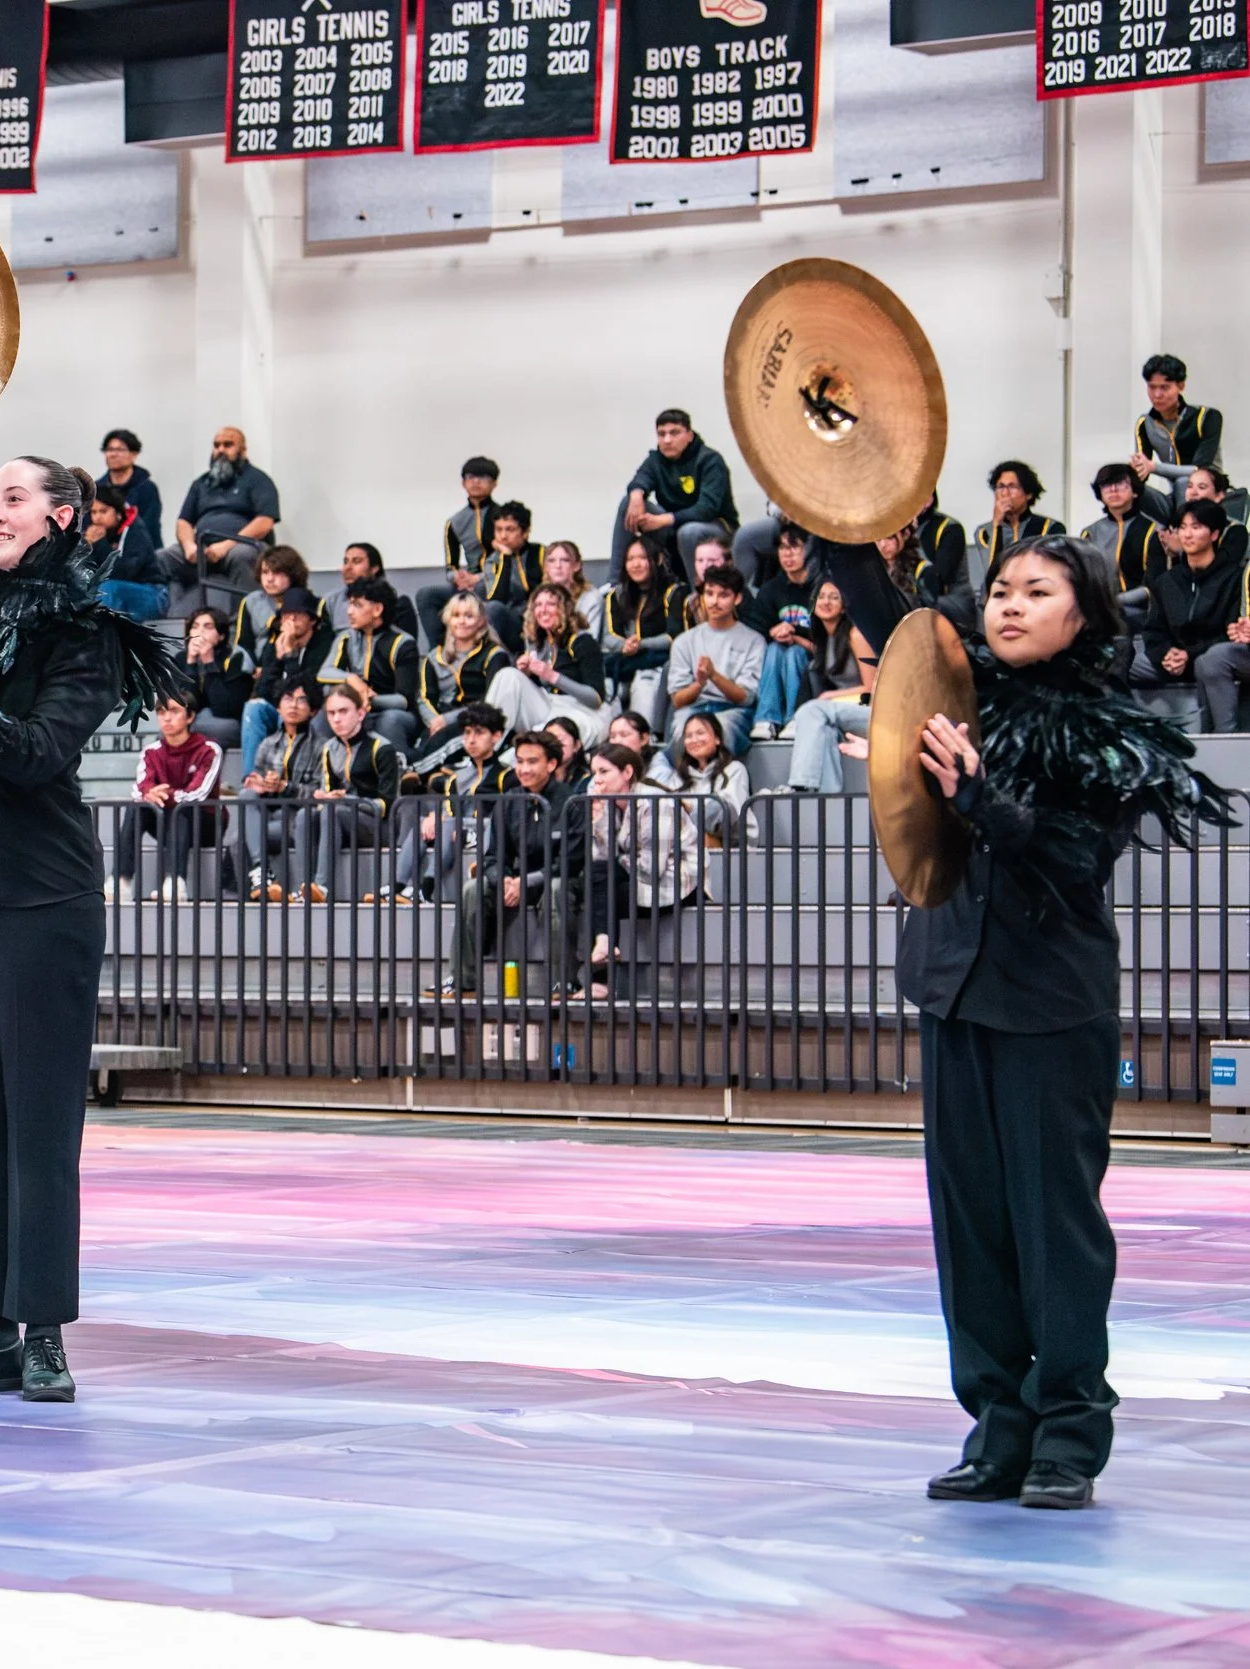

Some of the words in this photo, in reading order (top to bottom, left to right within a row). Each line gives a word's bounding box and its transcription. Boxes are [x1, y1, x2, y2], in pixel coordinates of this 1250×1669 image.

[247, 16, 305, 47] GIRLS
[316, 10, 390, 42] TENNIS
[452, 0, 500, 27] GIRLS
[511, 0, 572, 21] TENNIS
[1052, 1, 1103, 29] 2009
[1119, 0, 1167, 22] 2010
[429, 31, 470, 57] 2015
[487, 25, 530, 52] 2016
[548, 20, 592, 47] 2017
[645, 45, 701, 71] BOYS
[715, 34, 789, 67] TRACK
[1052, 29, 1101, 58] 2016
[1119, 20, 1167, 50] 2017
[1189, 12, 1236, 42] 2018
[240, 49, 283, 74] 2003
[294, 45, 338, 71] 2004
[350, 40, 393, 67] 2005
[428, 58, 469, 84] 2018
[485, 54, 528, 80] 2019
[547, 49, 591, 75] 2020
[1044, 58, 1086, 86] 2019
[1094, 52, 1138, 81] 2021
[1145, 46, 1192, 75] 2022
[239, 75, 282, 100] 2006
[293, 72, 336, 97] 2007
[349, 67, 392, 93] 2008
[484, 81, 526, 107] 2022
[632, 75, 679, 99] 1980
[691, 70, 742, 96] 1982
[754, 61, 803, 90] 1997
[237, 101, 281, 126] 2009
[292, 98, 333, 123] 2010
[348, 94, 384, 119] 2011
[630, 104, 681, 129] 1998
[692, 100, 743, 127] 1999
[752, 93, 804, 121] 2000
[237, 128, 278, 152] 2012
[292, 125, 332, 149] 2013
[346, 121, 385, 146] 2014
[628, 135, 680, 159] 2001
[690, 131, 743, 158] 2003
[748, 123, 807, 151] 2005
